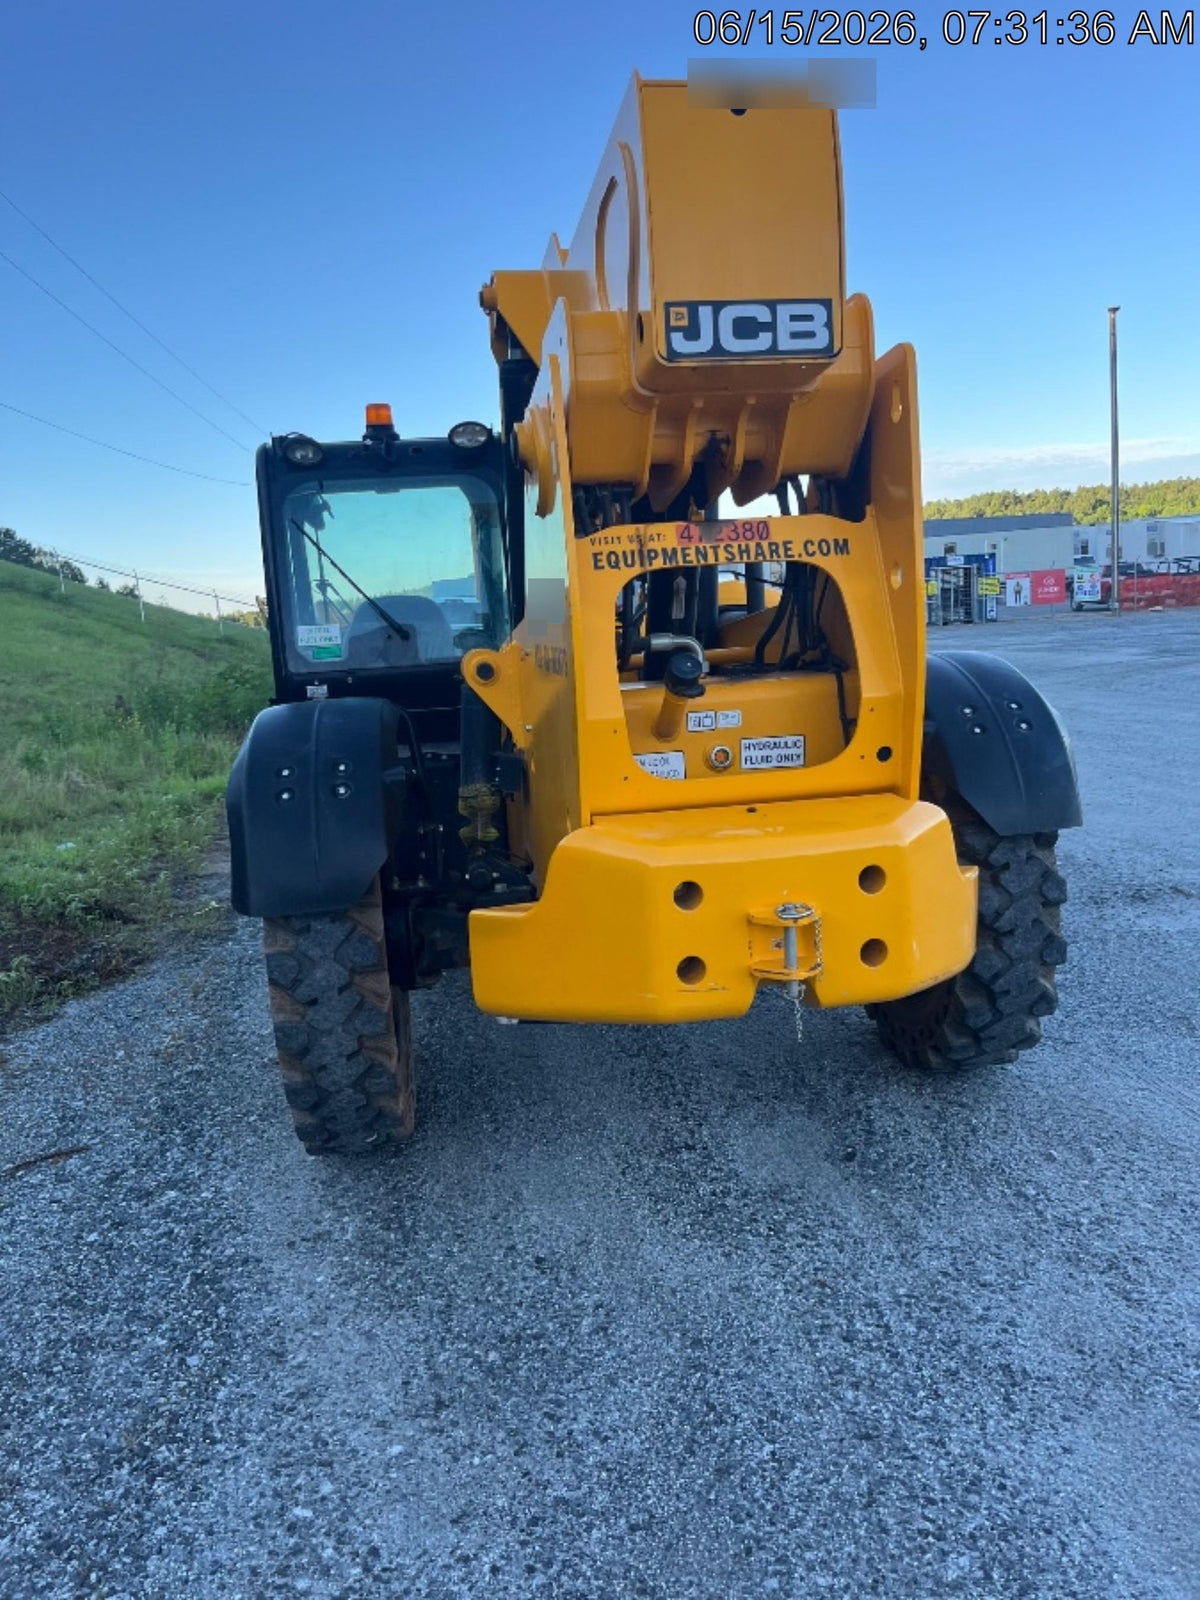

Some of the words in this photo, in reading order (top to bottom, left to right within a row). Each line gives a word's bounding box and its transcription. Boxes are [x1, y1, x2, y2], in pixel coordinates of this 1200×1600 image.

[669, 303, 830, 354] JCB
[589, 535, 622, 547] VISIT
[592, 537, 851, 571] EQUIPMENTSHARE.COM
[744, 739, 802, 751] HYDRAULIC
[744, 754, 772, 766] FLUID
[776, 753, 801, 764] ONLY
